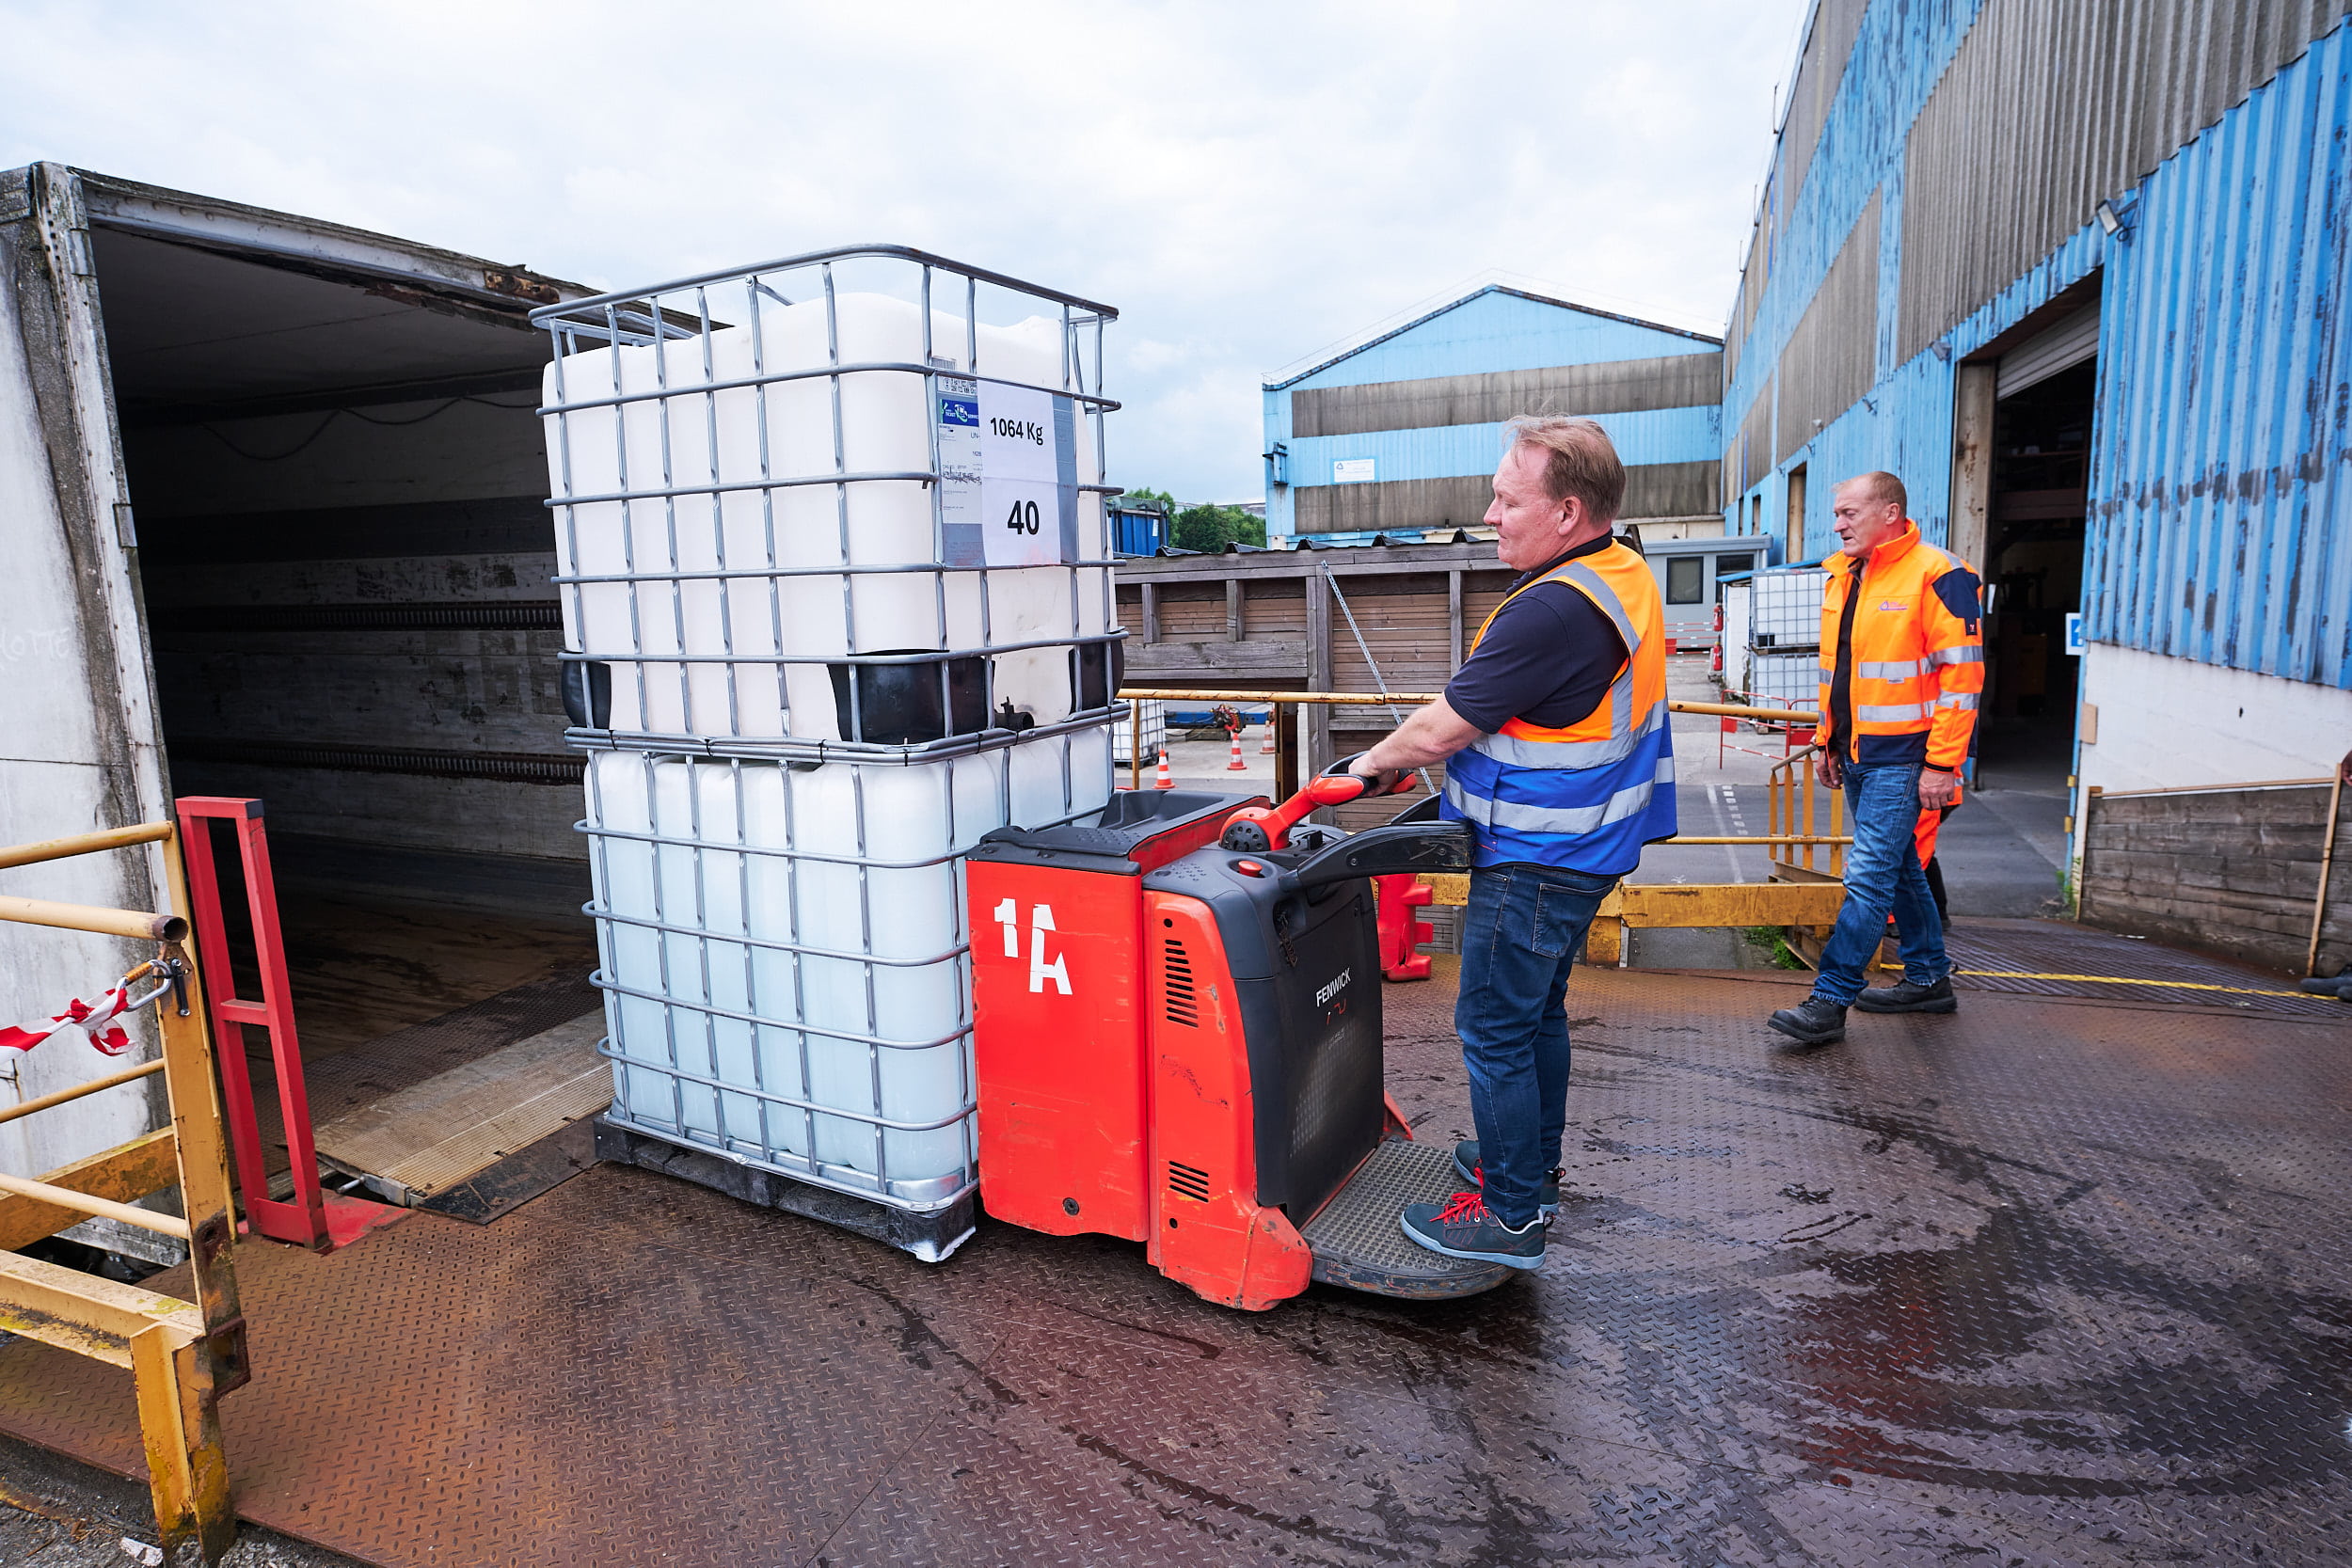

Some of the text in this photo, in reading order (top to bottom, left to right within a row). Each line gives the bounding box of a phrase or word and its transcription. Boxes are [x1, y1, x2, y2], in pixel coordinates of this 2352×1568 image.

[990, 417, 1043, 446] 1064 Kg
[1007, 499, 1040, 535] 40
[1316, 967, 1351, 1007] FENWICK
